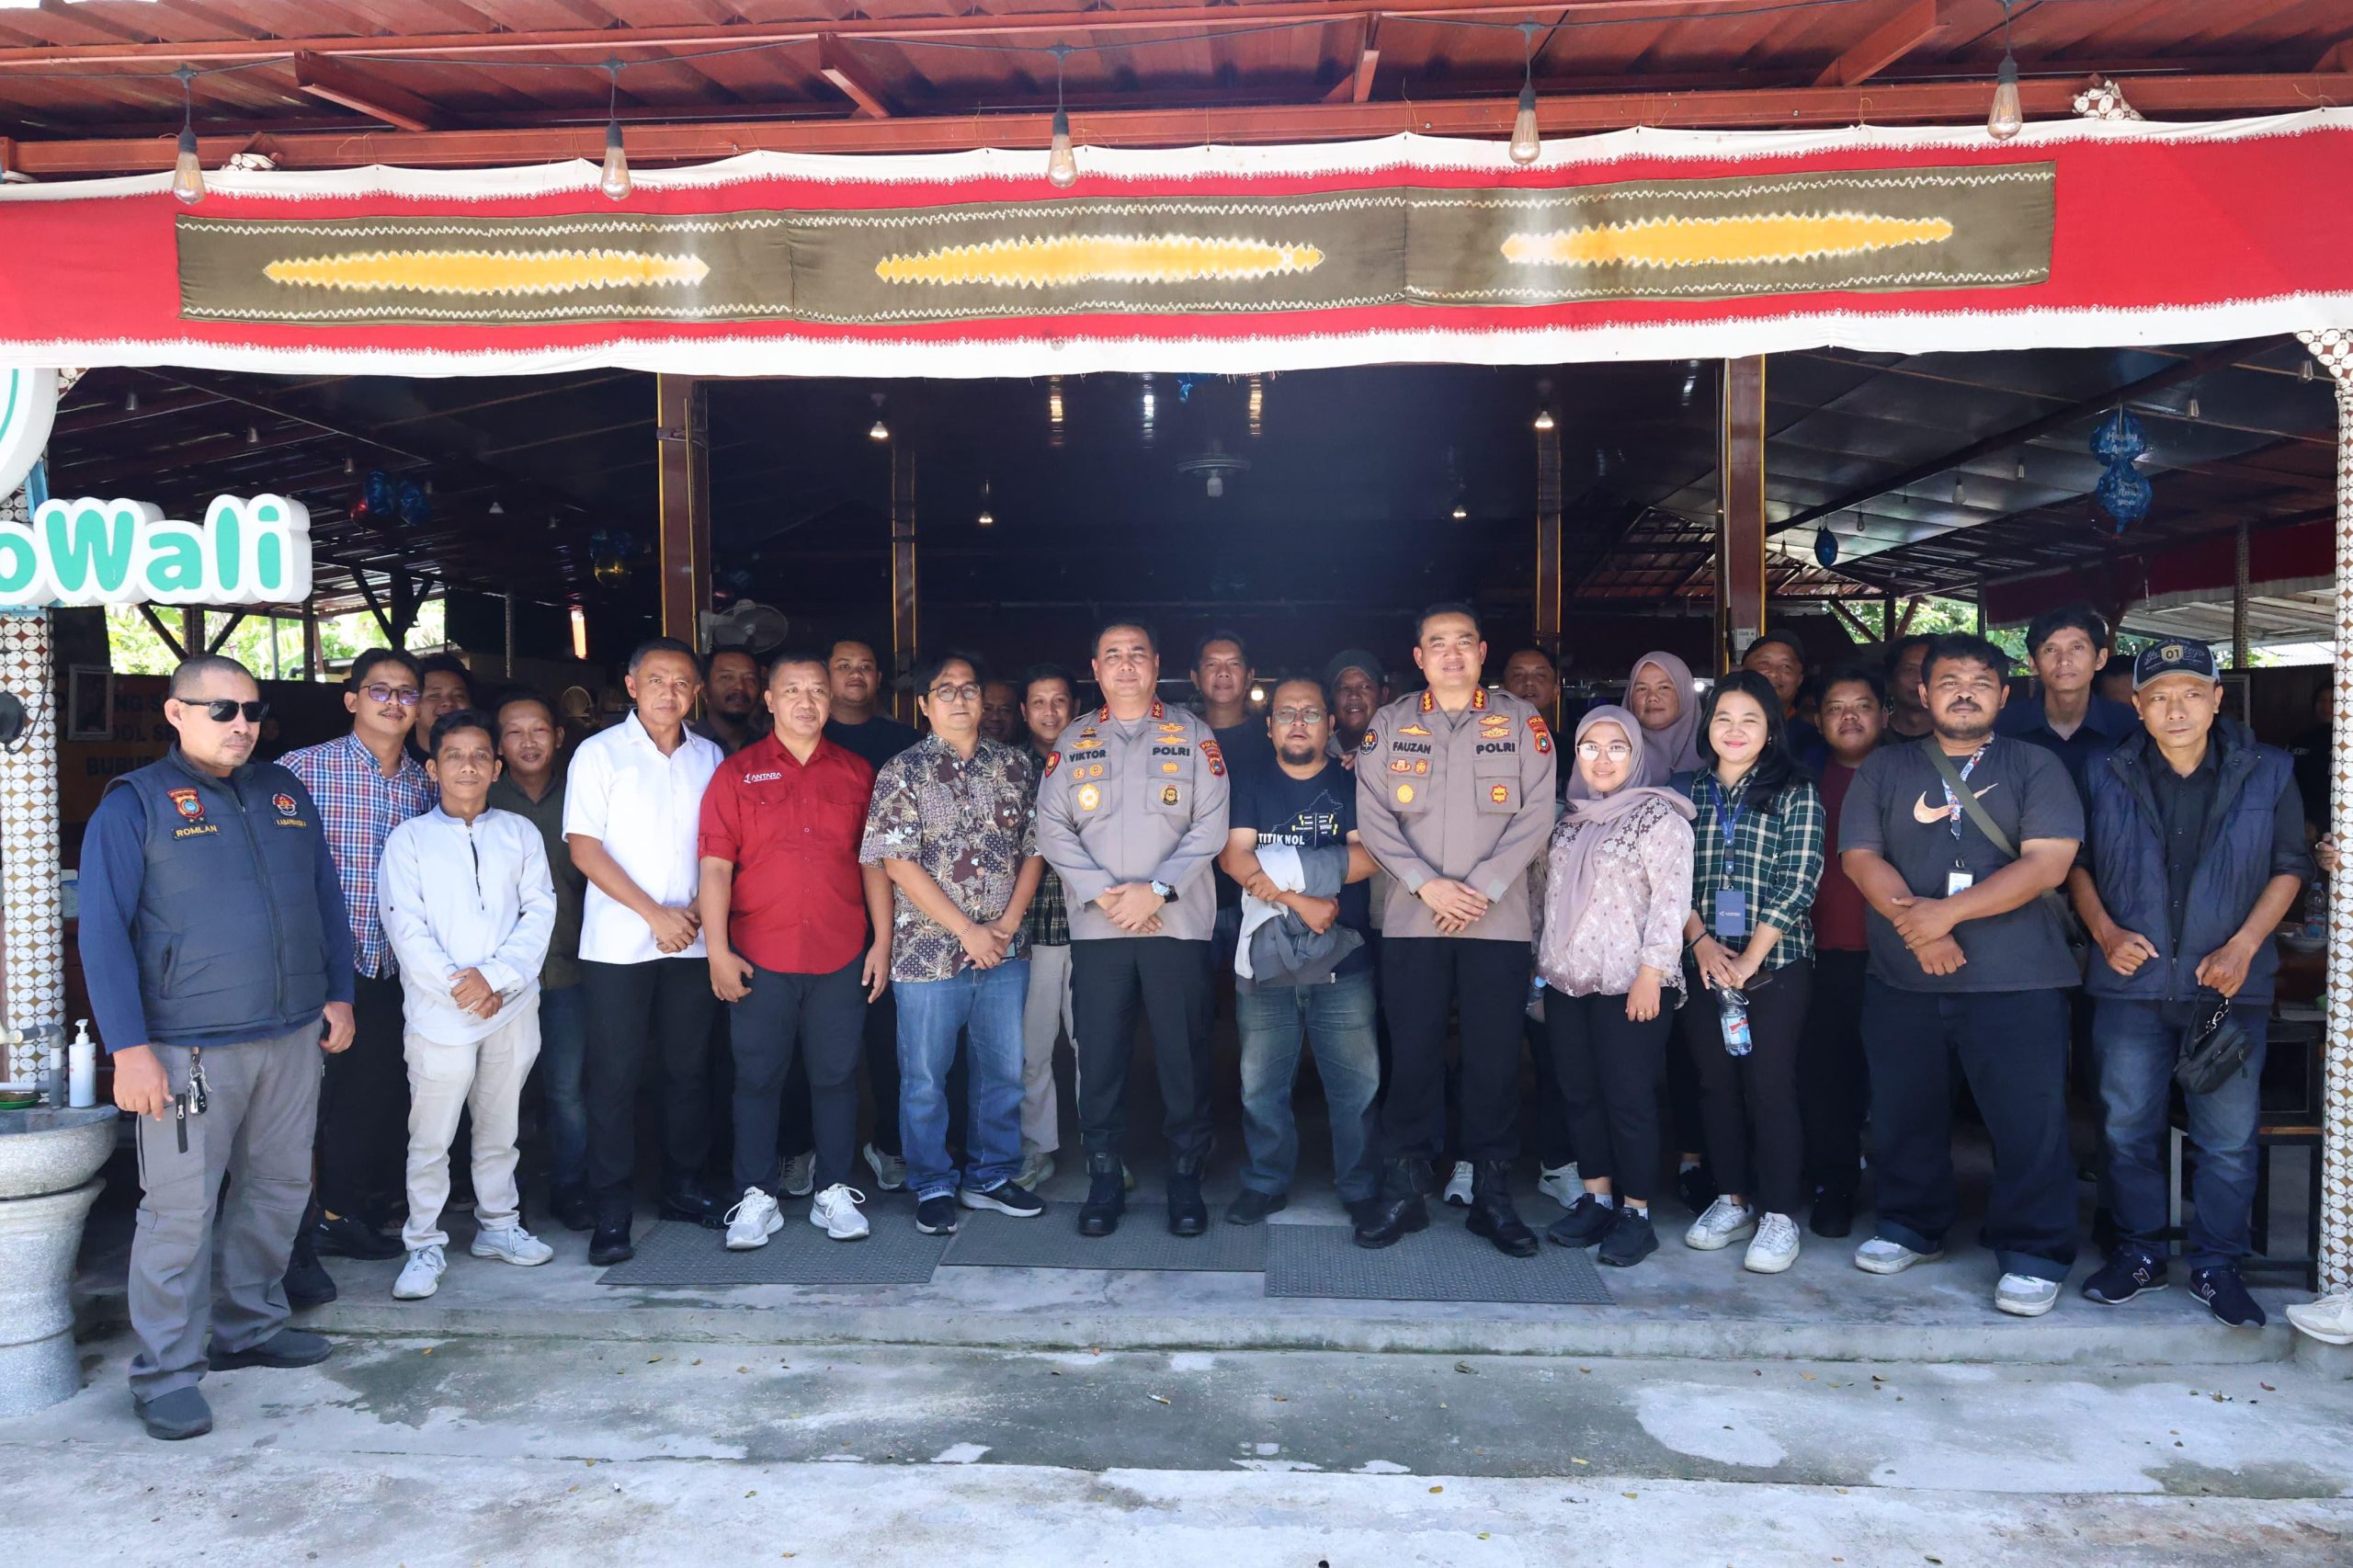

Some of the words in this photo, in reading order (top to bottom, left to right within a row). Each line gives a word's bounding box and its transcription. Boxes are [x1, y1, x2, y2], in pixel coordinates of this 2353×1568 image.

[2165, 649, 2179, 659] 01
[1153, 746, 1190, 756] POLRI
[1392, 741, 1431, 754] FAUZAN
[1476, 743, 1516, 755] POLRI
[1069, 749, 1107, 763] VIKTOR
[751, 772, 782, 781] ANTARA
[176, 824, 218, 837] ROMLAN
[1257, 833, 1284, 844] TITIK
[1285, 835, 1305, 846] NOL
